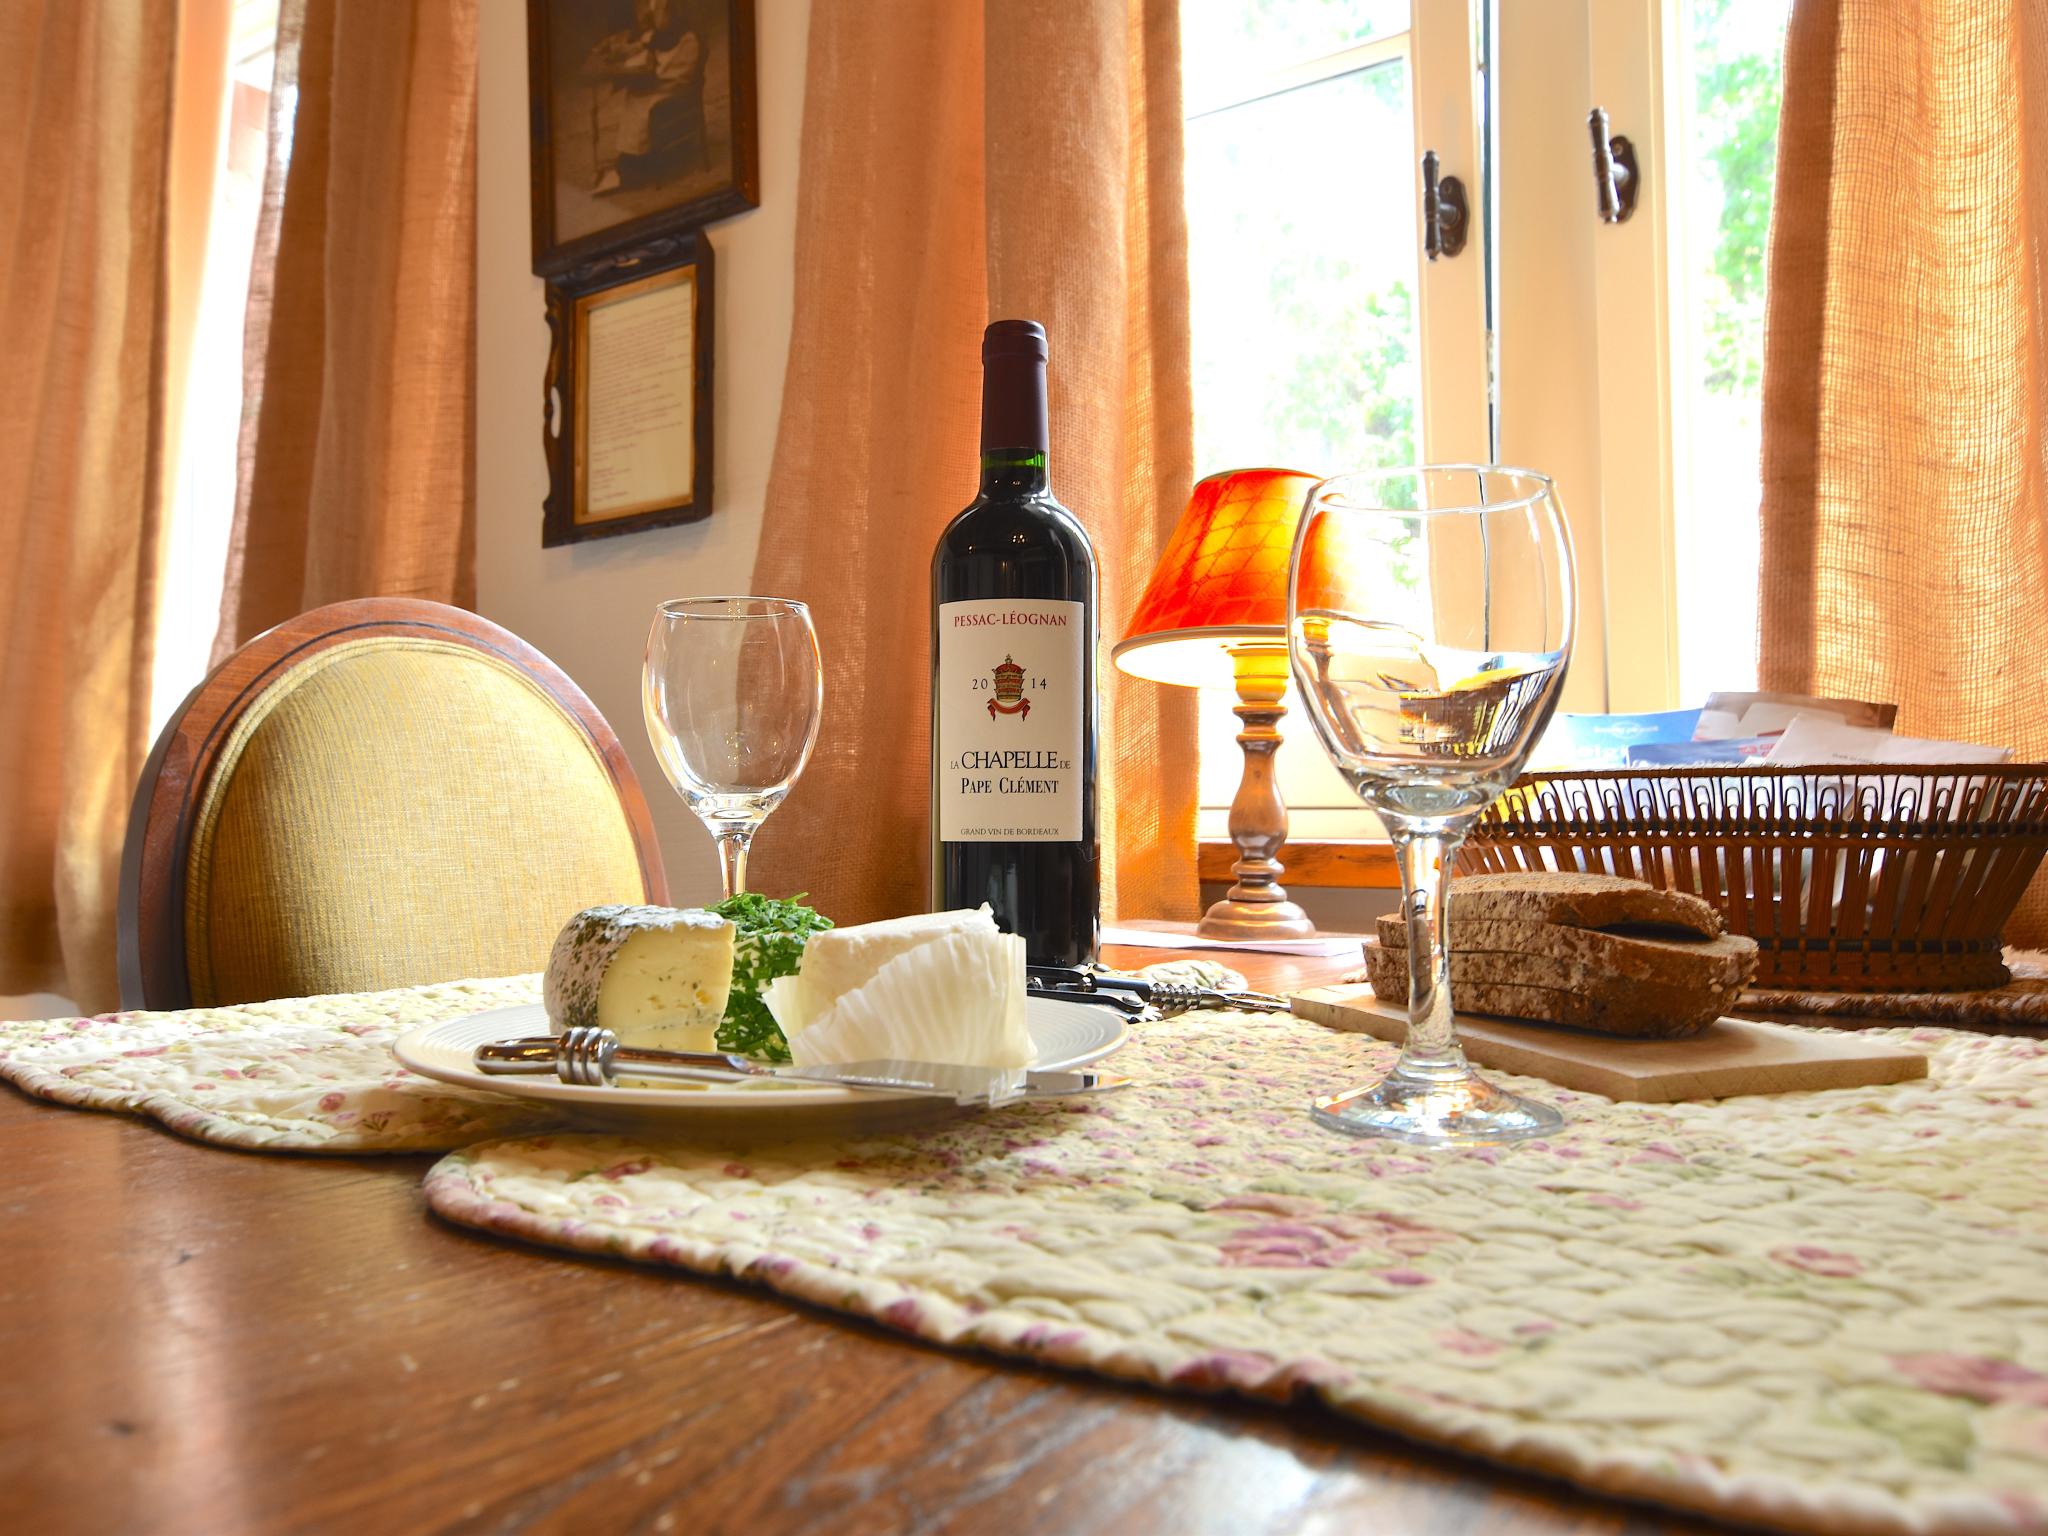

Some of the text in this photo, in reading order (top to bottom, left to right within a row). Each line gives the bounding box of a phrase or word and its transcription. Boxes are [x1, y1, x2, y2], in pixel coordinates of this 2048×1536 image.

[954, 611, 1067, 627] PESSAC-LÉOGNAN
[950, 751, 1071, 770] LA CHAPELLE DE
[961, 776, 1059, 794] PAPE CLÉMENT
[960, 828, 1059, 836] GRAND VIN DE BORDEAUX
